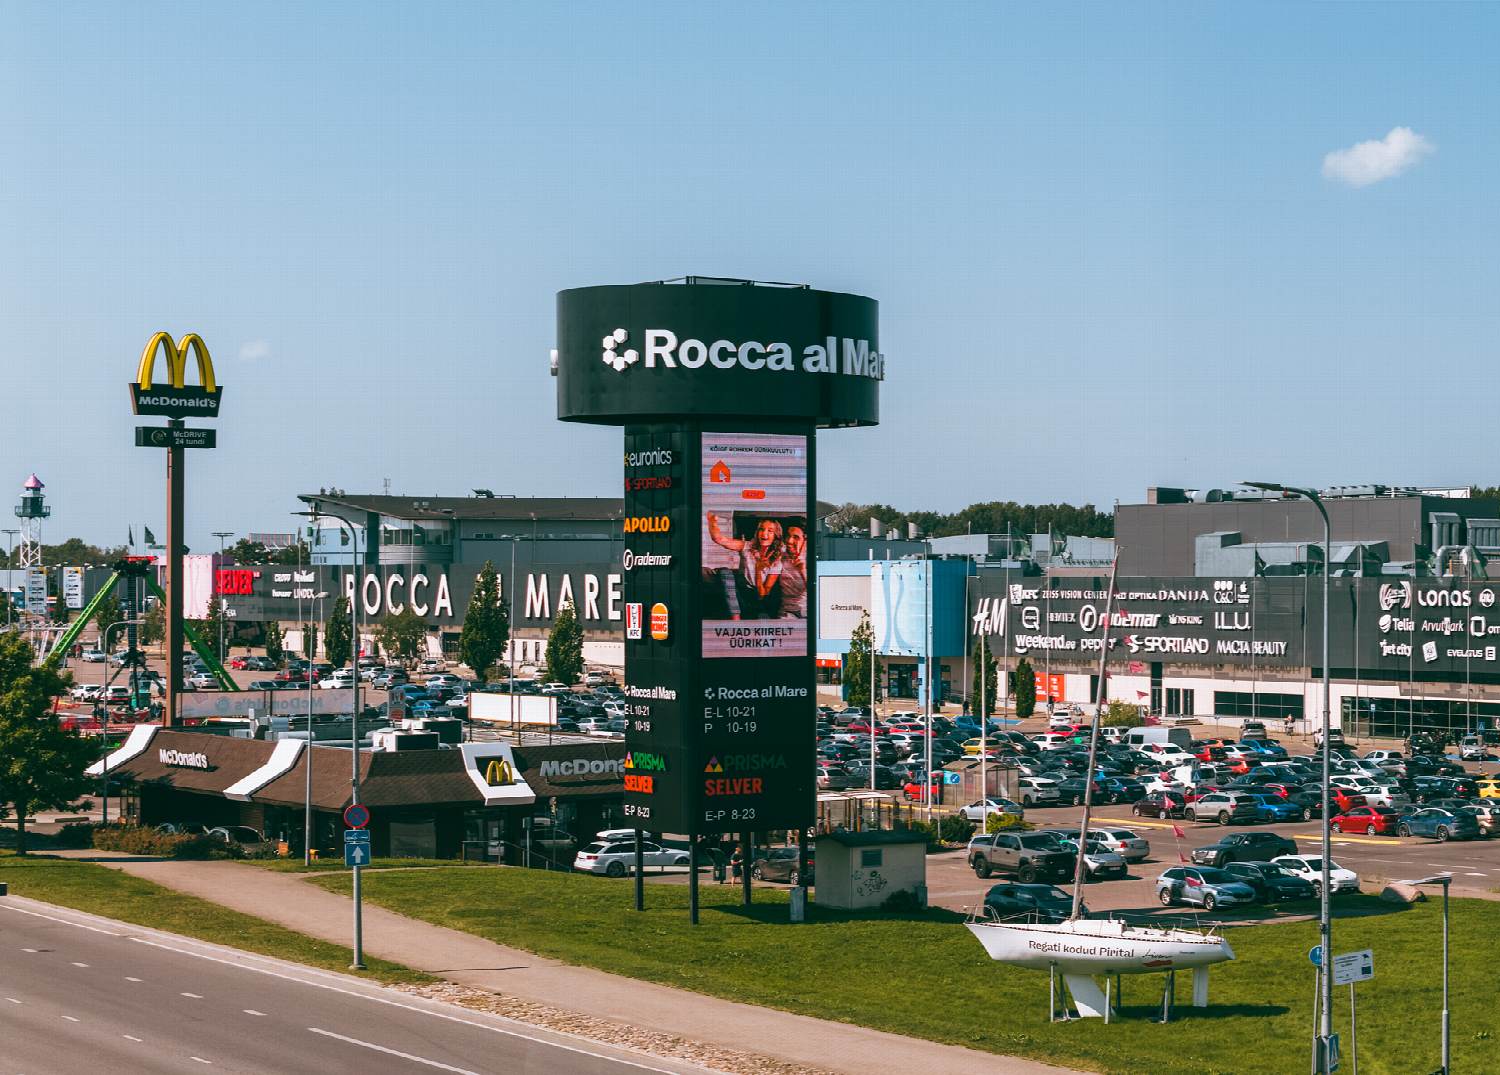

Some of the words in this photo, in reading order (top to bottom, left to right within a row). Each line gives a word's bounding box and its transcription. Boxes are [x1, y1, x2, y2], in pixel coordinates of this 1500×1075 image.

[645, 329, 794, 371] Rocca
[803, 336, 837, 374] al
[139, 396, 217, 408] McDonald's
[630, 447, 672, 466] euronics
[624, 516, 670, 533] APOLLO
[634, 552, 672, 566] rademar
[345, 573, 453, 616] ROCCA
[525, 573, 621, 620] MARE
[1042, 590, 1059, 599] ZEISS
[1061, 590, 1082, 599] VISION
[1083, 590, 1107, 600] CENTER
[1129, 592, 1157, 600] OPTIKA
[1159, 590, 1209, 600] DANIJA
[973, 598, 1007, 636] H&M
[1393, 617, 1415, 632] Telia
[715, 628, 751, 637] VAJAD
[754, 627, 794, 636] KIIRELT
[730, 638, 776, 648] ÜÜRIKAT
[1015, 635, 1076, 650] Weekend.ee
[1144, 636, 1210, 653] SPORTLAND
[1252, 641, 1288, 655] BEAUTY
[1447, 649, 1483, 658] EVELATUS
[631, 685, 651, 698] Rocca
[652, 686, 658, 699] al
[658, 686, 676, 700] Mare
[718, 687, 759, 700] Rocca
[762, 686, 772, 698] al
[775, 685, 808, 698] Mare
[624, 704, 634, 715] E-L
[635, 705, 650, 716] 10-21
[705, 707, 723, 719] E-L
[727, 706, 756, 718] 10-21
[624, 720, 629, 730] P
[635, 720, 650, 732] 10-19
[705, 723, 713, 733] P
[727, 721, 757, 733] 10-19
[159, 748, 208, 768] McDonald's
[634, 751, 666, 771] PRISMA
[724, 754, 788, 770] PRISMA
[624, 774, 653, 794] SELVER
[705, 778, 763, 796] SELVER
[624, 804, 635, 816] E-P
[637, 806, 650, 818] 8-23
[705, 810, 725, 822] E-P
[731, 808, 756, 820] 8-23
[1029, 940, 1061, 952] Regati
[1064, 944, 1096, 956] kodud
[1100, 947, 1135, 958] Pirital
